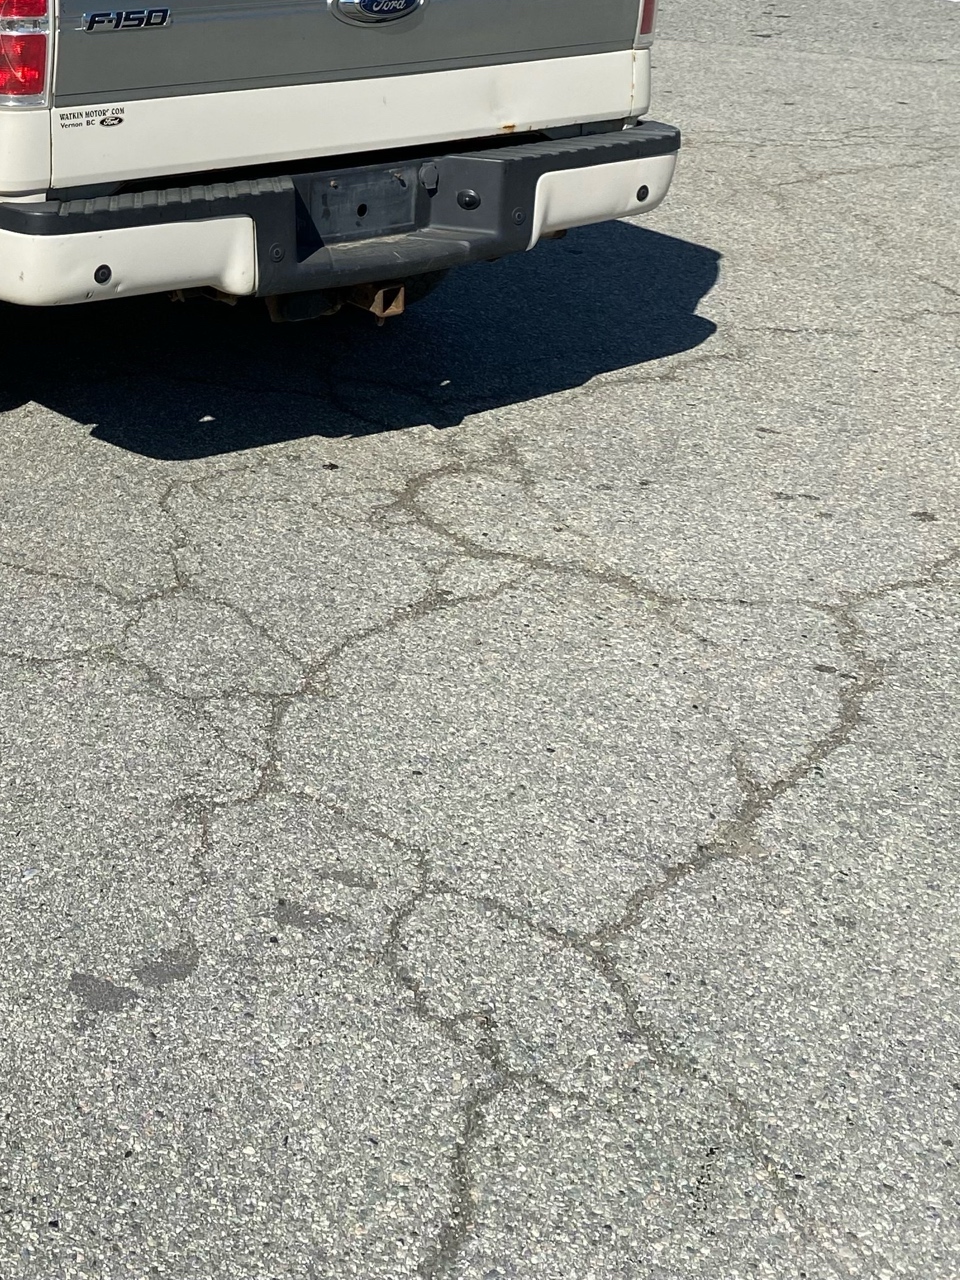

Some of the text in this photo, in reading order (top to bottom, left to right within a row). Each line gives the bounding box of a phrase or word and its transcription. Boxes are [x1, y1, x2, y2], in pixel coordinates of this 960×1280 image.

[86, 8, 171, 31] F-150
[59, 112, 83, 120] WATKIN
[86, 119, 96, 127] BC
